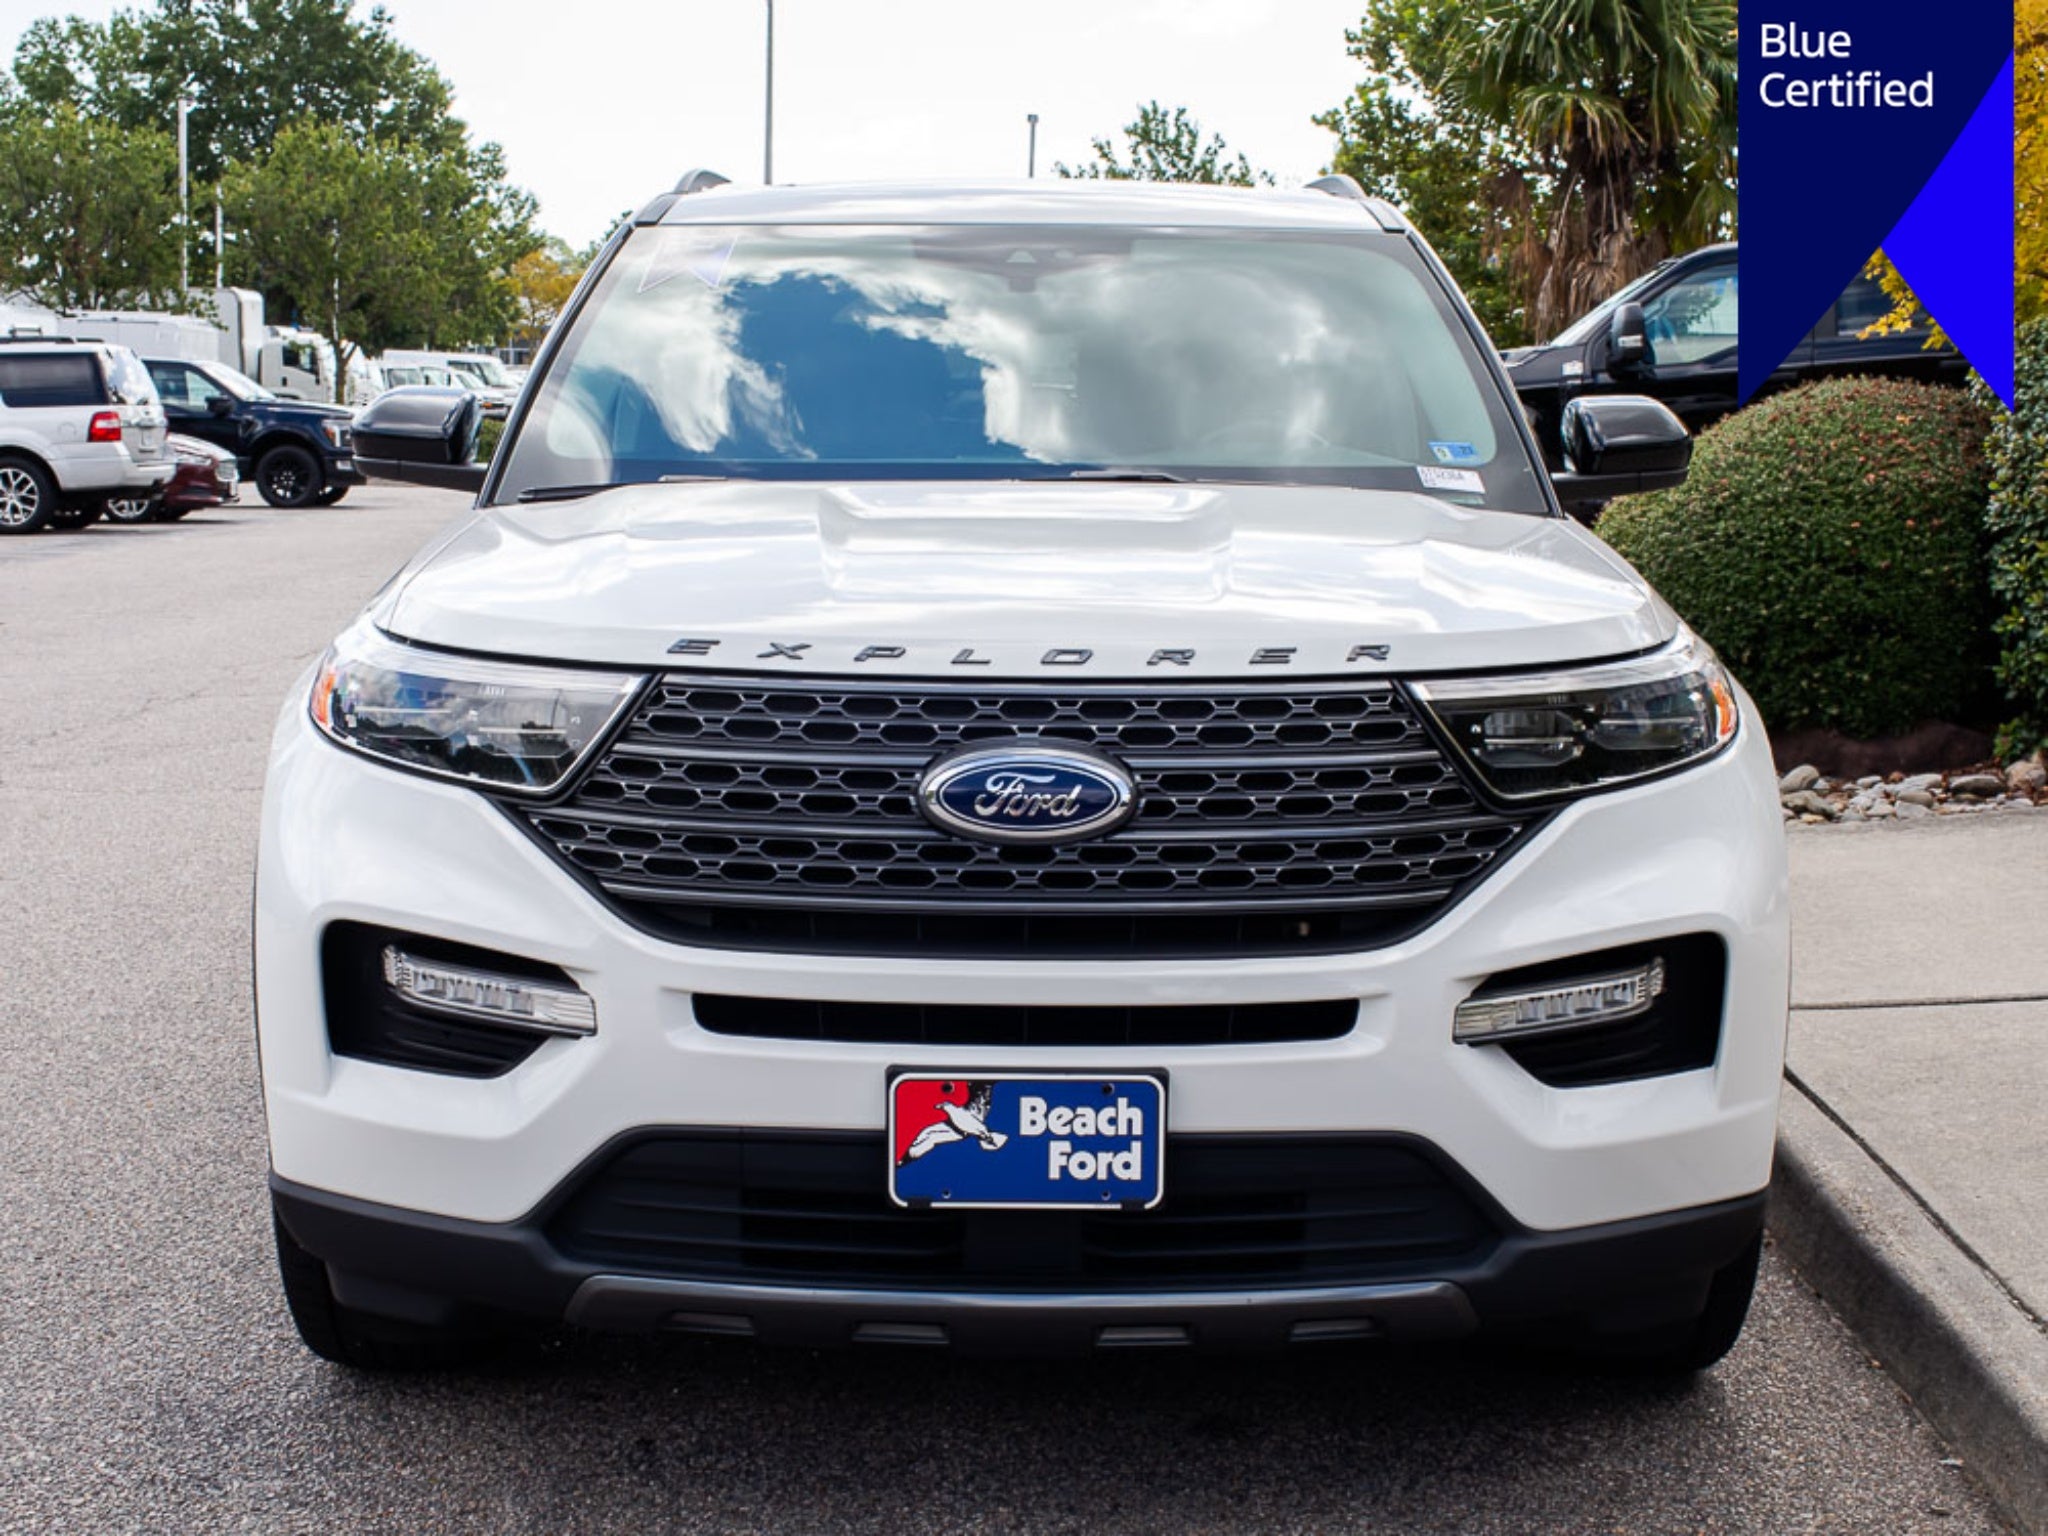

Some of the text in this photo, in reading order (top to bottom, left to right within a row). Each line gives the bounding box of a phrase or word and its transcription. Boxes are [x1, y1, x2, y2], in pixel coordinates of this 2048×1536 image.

[667, 637, 1392, 667] EXPLORER
[974, 771, 1082, 818] Ford
[1019, 1096, 1144, 1137] Beach
[1048, 1140, 1143, 1181] Ford
